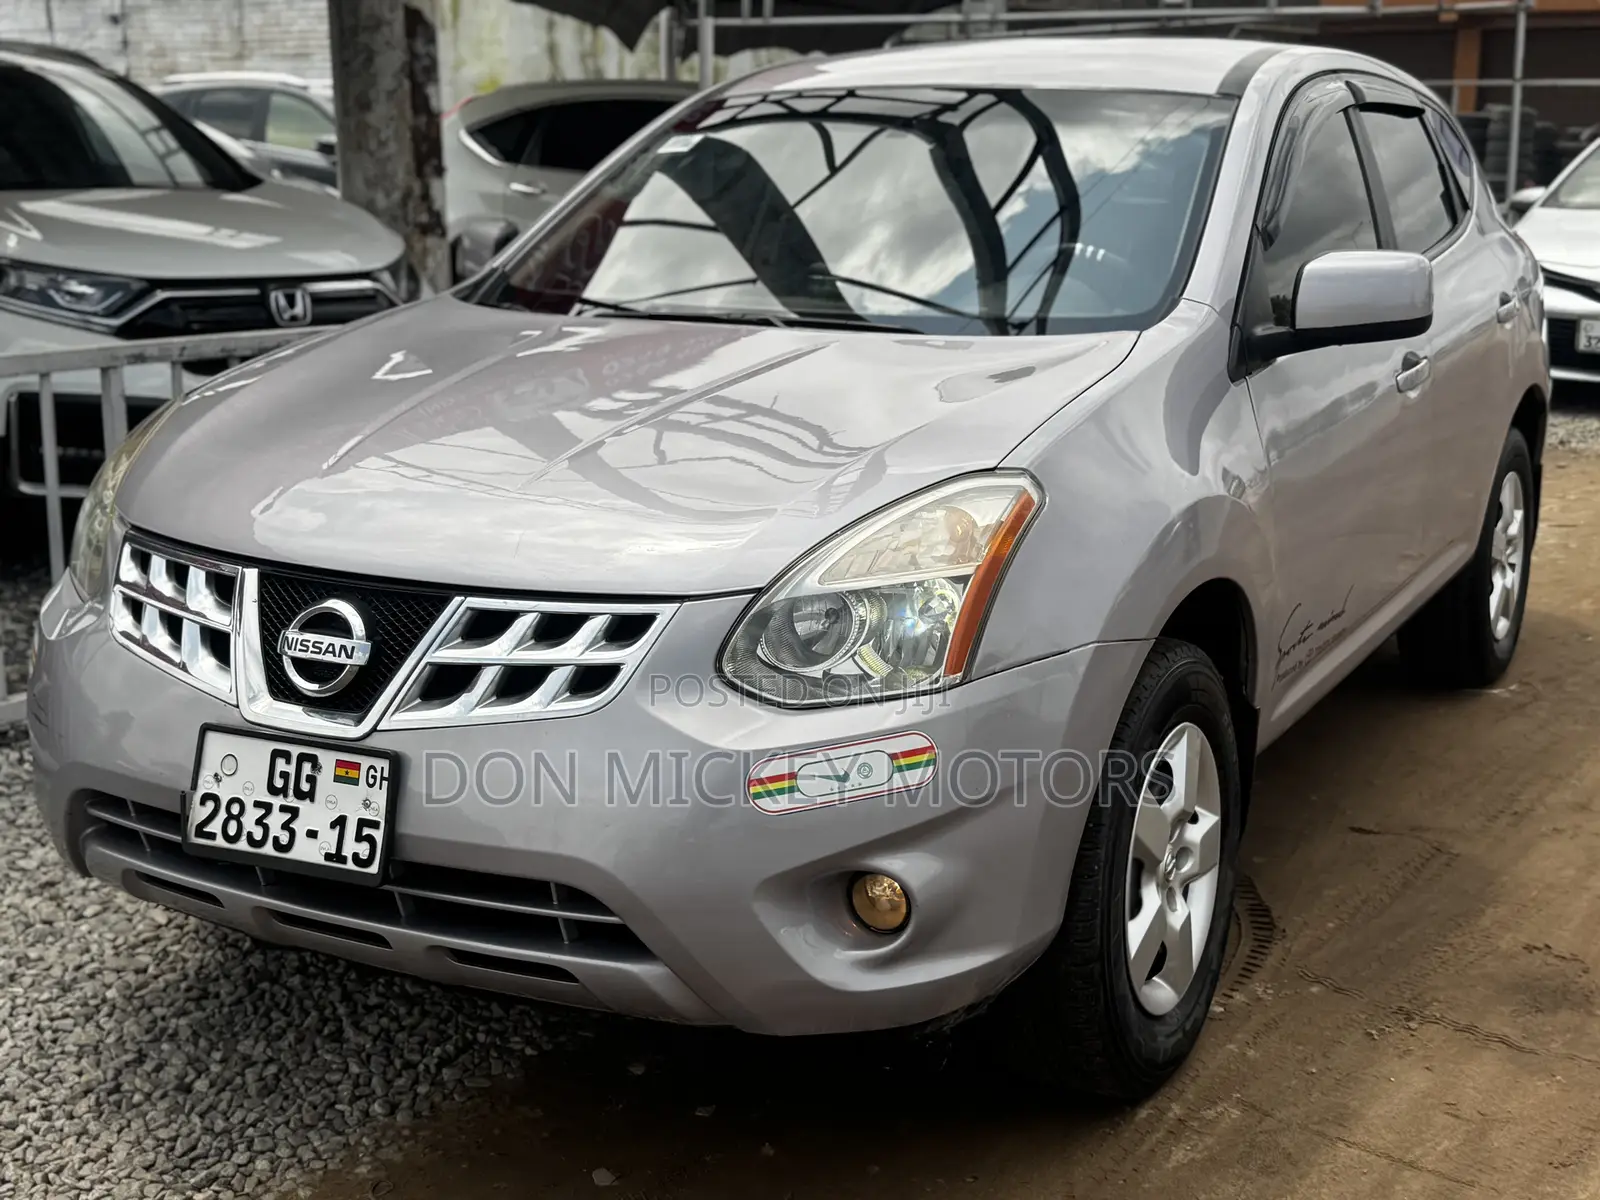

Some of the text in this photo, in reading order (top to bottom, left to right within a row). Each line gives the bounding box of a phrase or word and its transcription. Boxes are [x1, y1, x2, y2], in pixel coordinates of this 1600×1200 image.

[282, 635, 355, 660] NISSAN
[266, 748, 319, 803] GG
[194, 792, 382, 869] 2833-15
